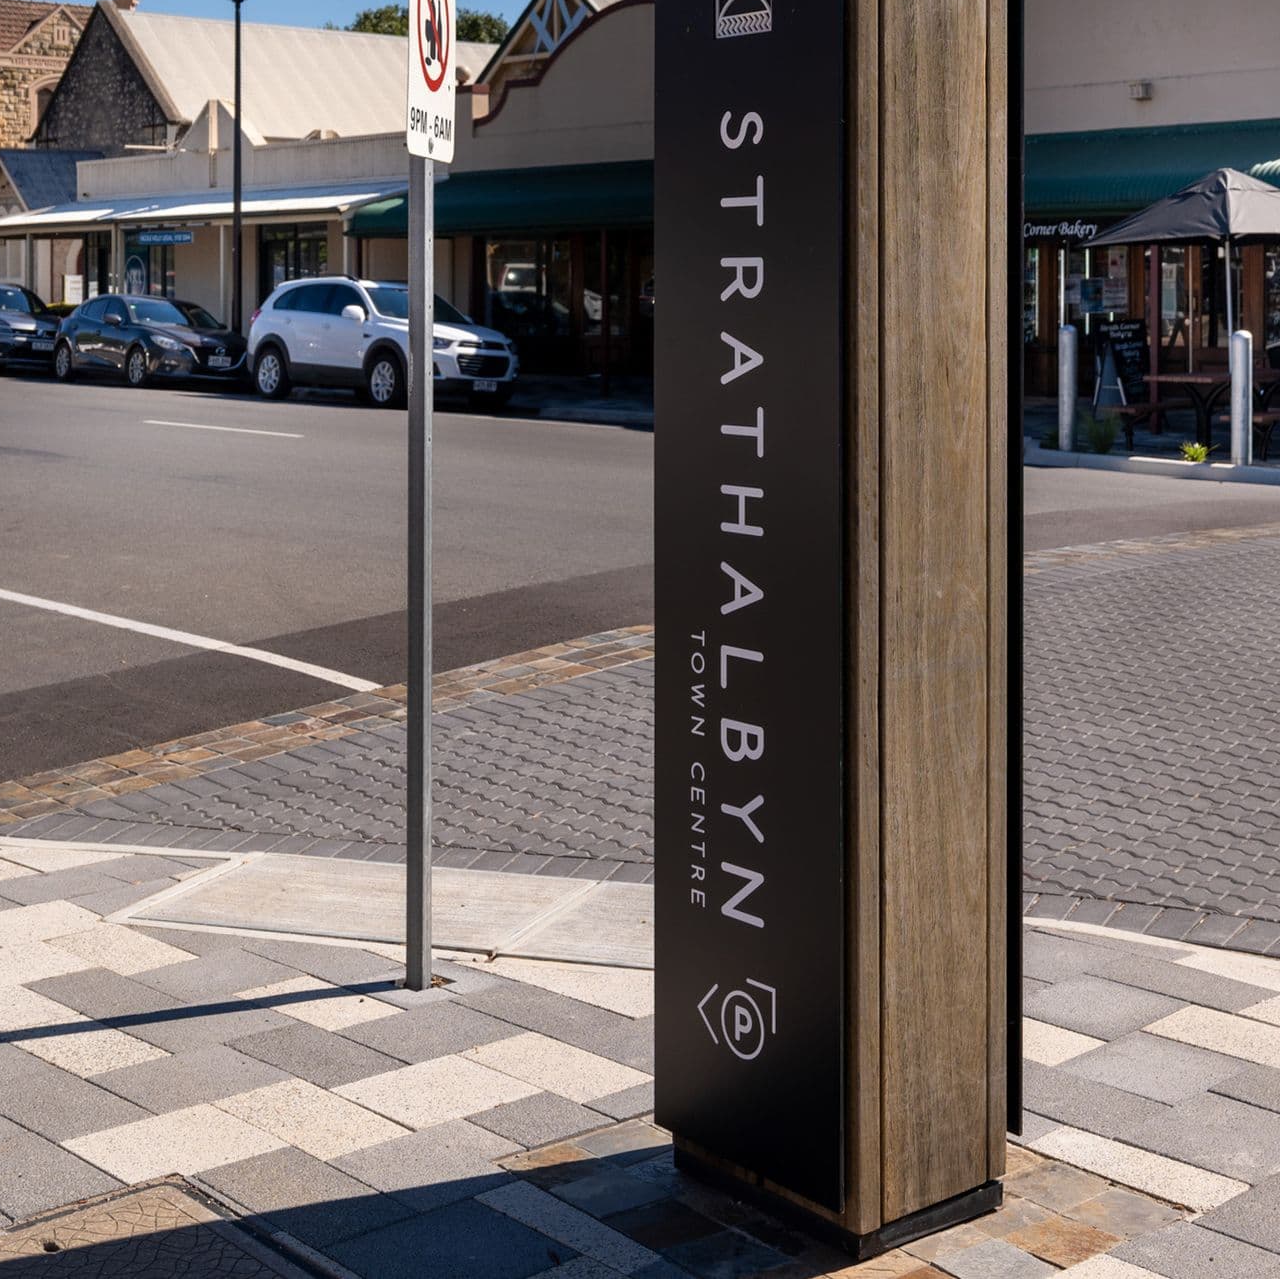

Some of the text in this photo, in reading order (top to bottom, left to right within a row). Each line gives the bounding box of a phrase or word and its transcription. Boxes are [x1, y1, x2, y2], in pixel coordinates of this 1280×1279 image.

[410, 106, 428, 135] 9PM
[433, 115, 452, 142] 6AM
[1023, 219, 1098, 240] Corner Bakery
[719, 110, 765, 929] STRATHALBYN
[689, 629, 707, 909] TOWN CENTRE
